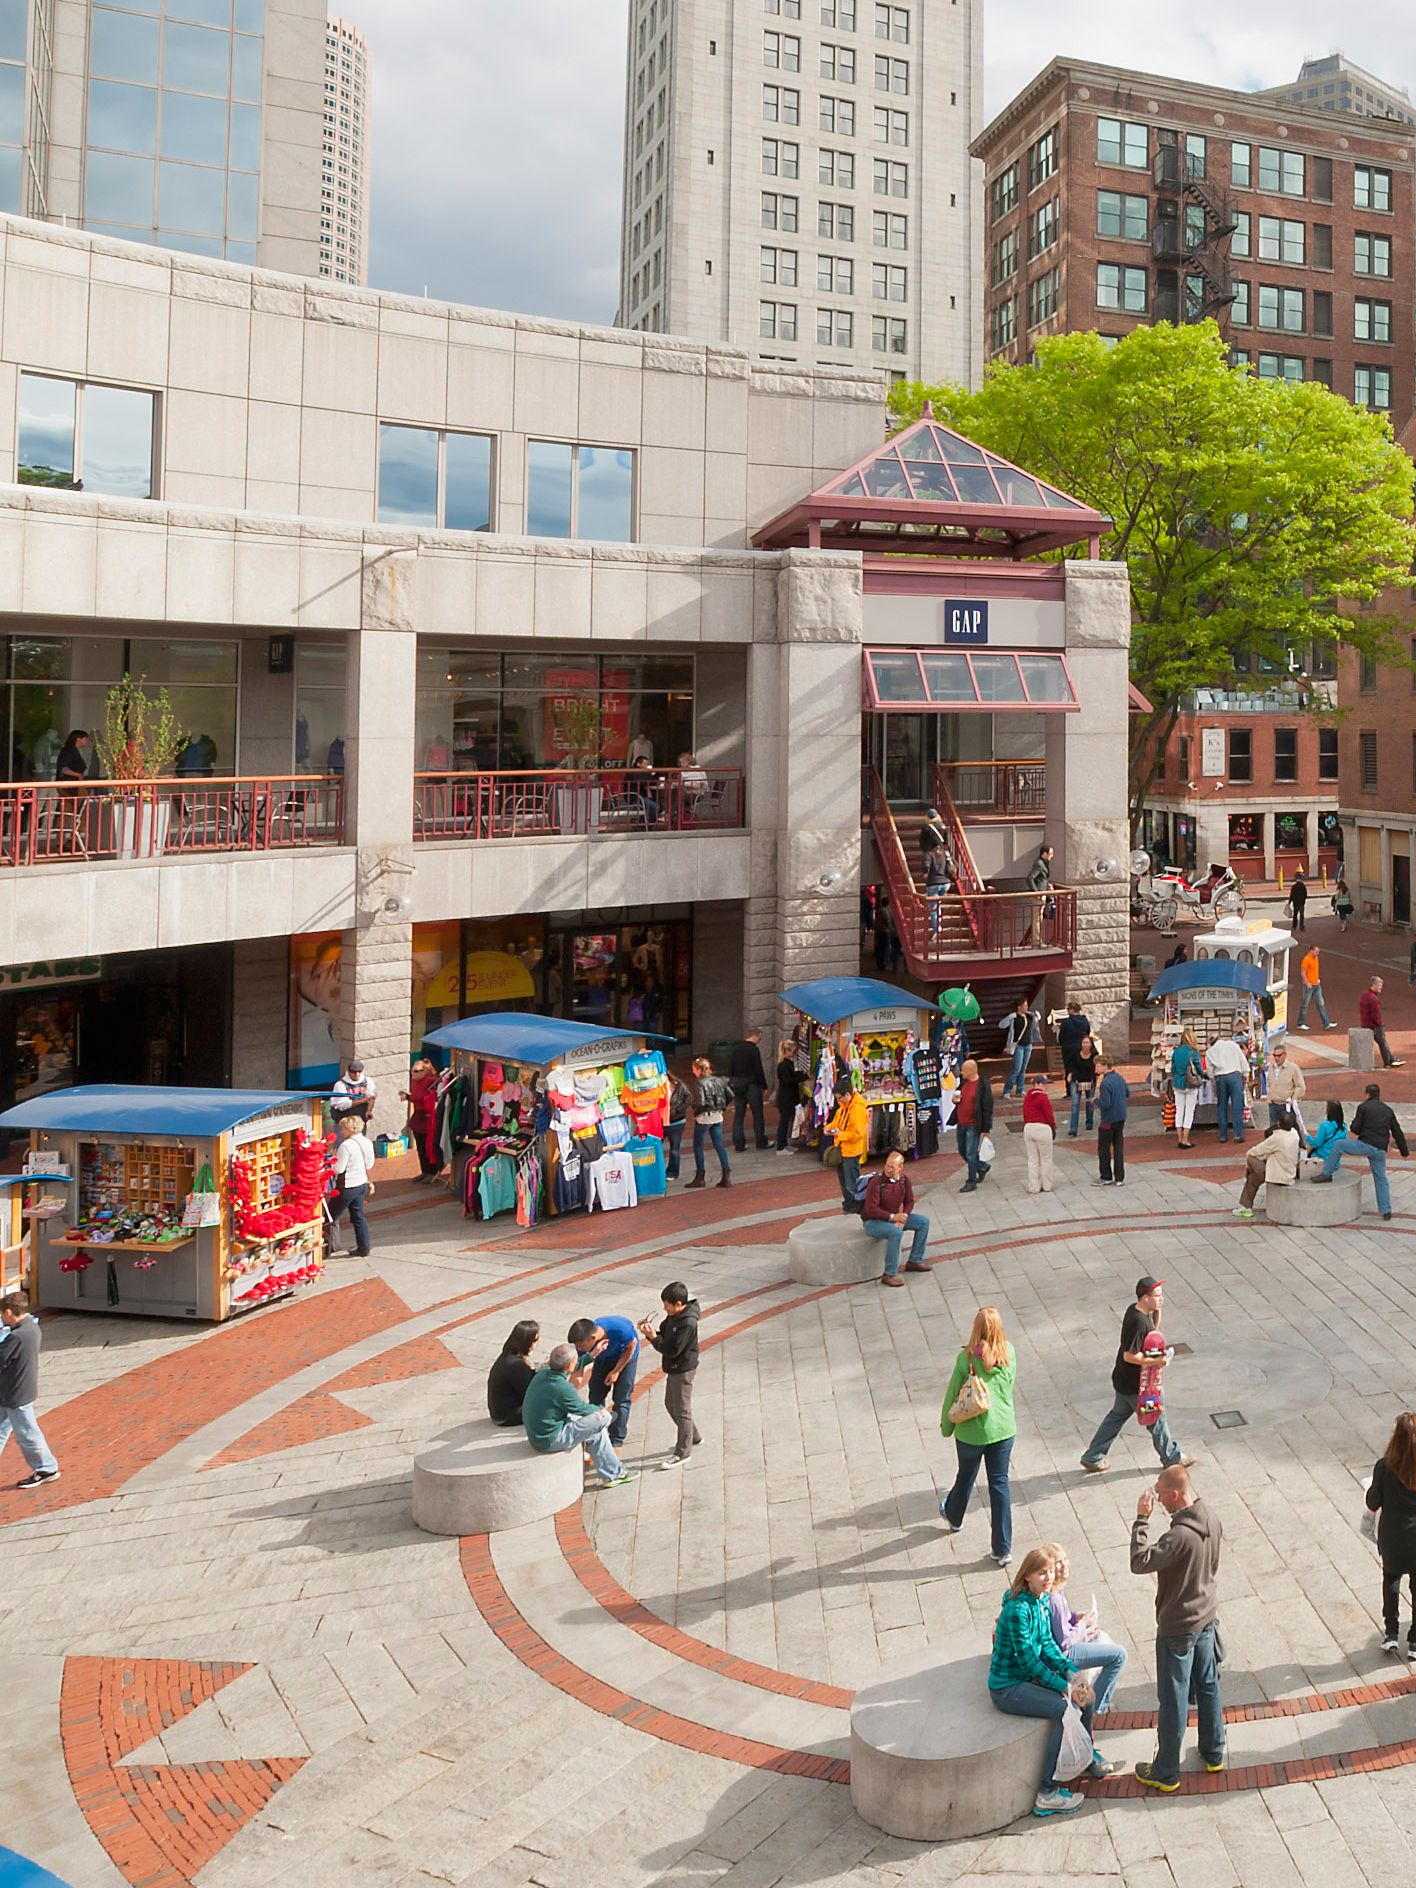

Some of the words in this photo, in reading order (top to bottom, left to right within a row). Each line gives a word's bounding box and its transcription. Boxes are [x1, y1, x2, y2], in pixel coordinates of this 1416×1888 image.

[952, 609, 981, 634] GAP
[1198, 990, 1206, 999] OF
[1207, 989, 1217, 999] THE
